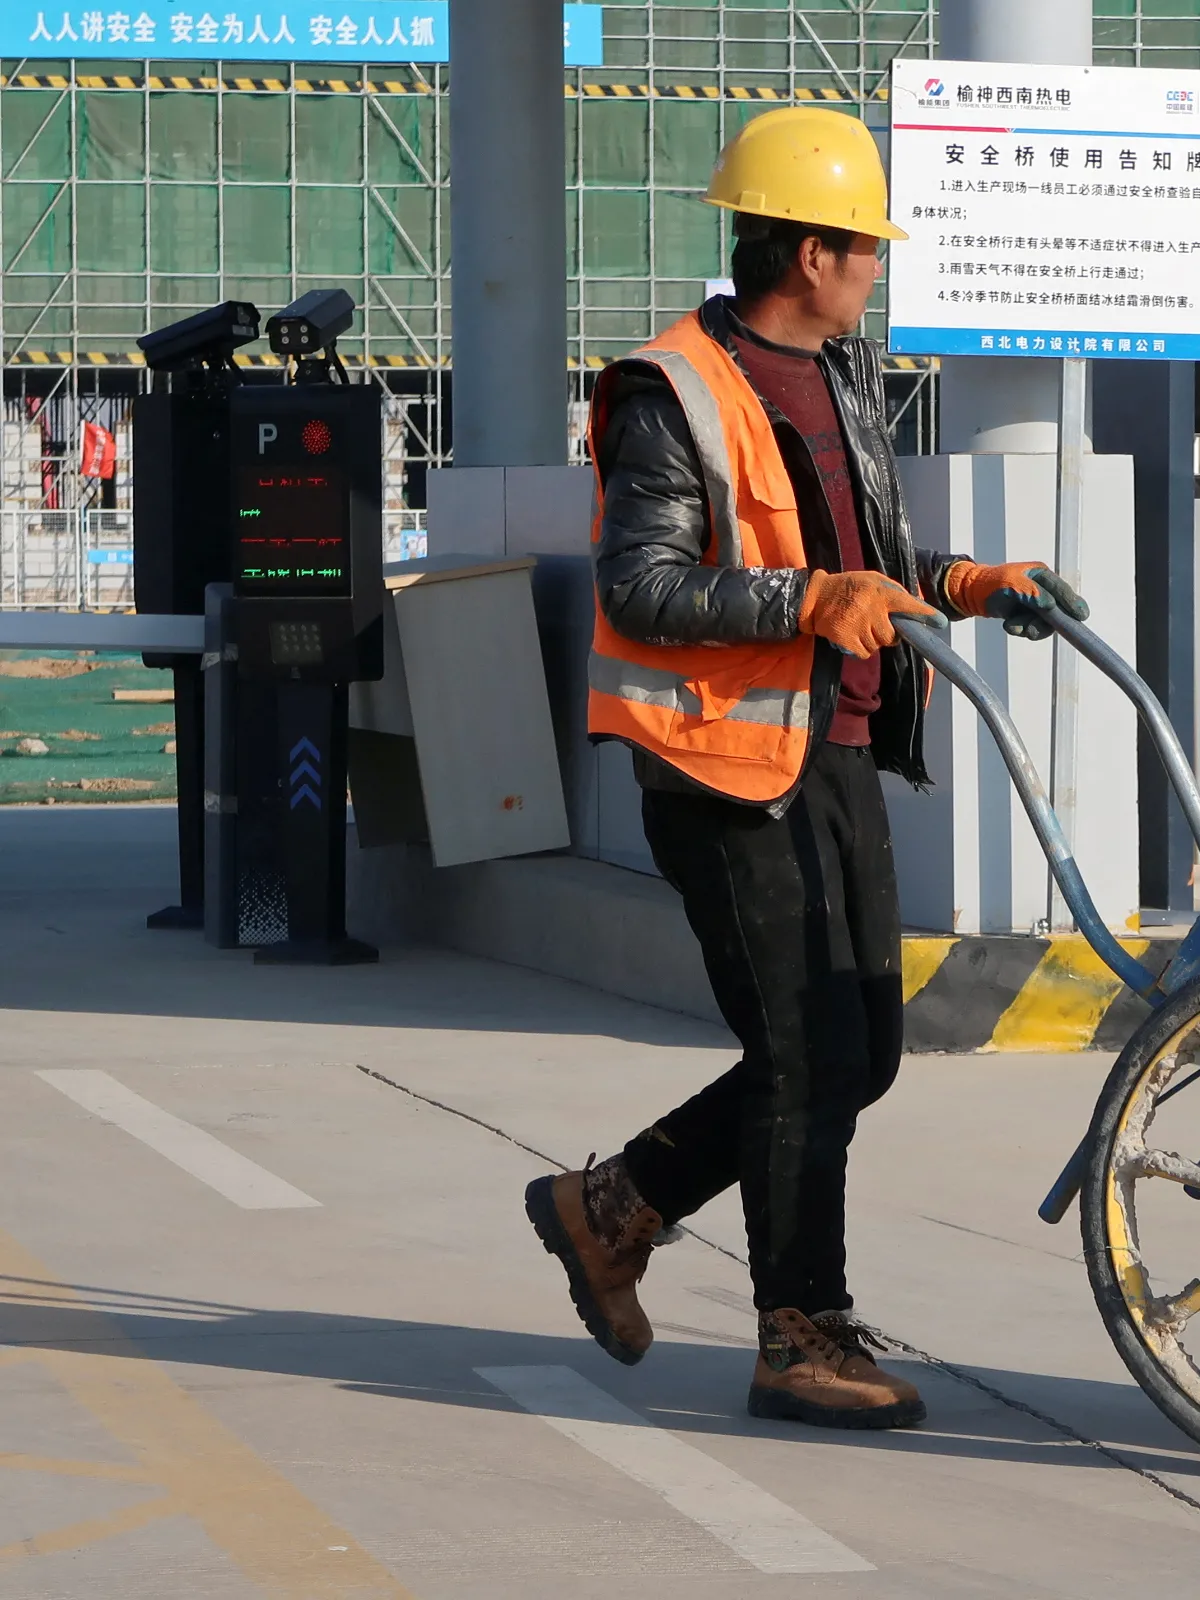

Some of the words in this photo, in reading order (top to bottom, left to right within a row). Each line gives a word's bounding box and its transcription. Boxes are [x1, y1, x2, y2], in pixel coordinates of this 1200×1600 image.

[29, 11, 156, 42] 人人讲安全
[170, 12, 296, 44] 安全为人人
[309, 14, 435, 46] 安全人人抓
[956, 84, 1072, 106] 榆神西南热电
[937, 290, 1195, 309] 4.冬冷季节防止安全桥桥面结冰结霜滑倒伤害。
[980, 335, 1165, 353] 西北电力设计院有限公司
[258, 423, 278, 455] P
